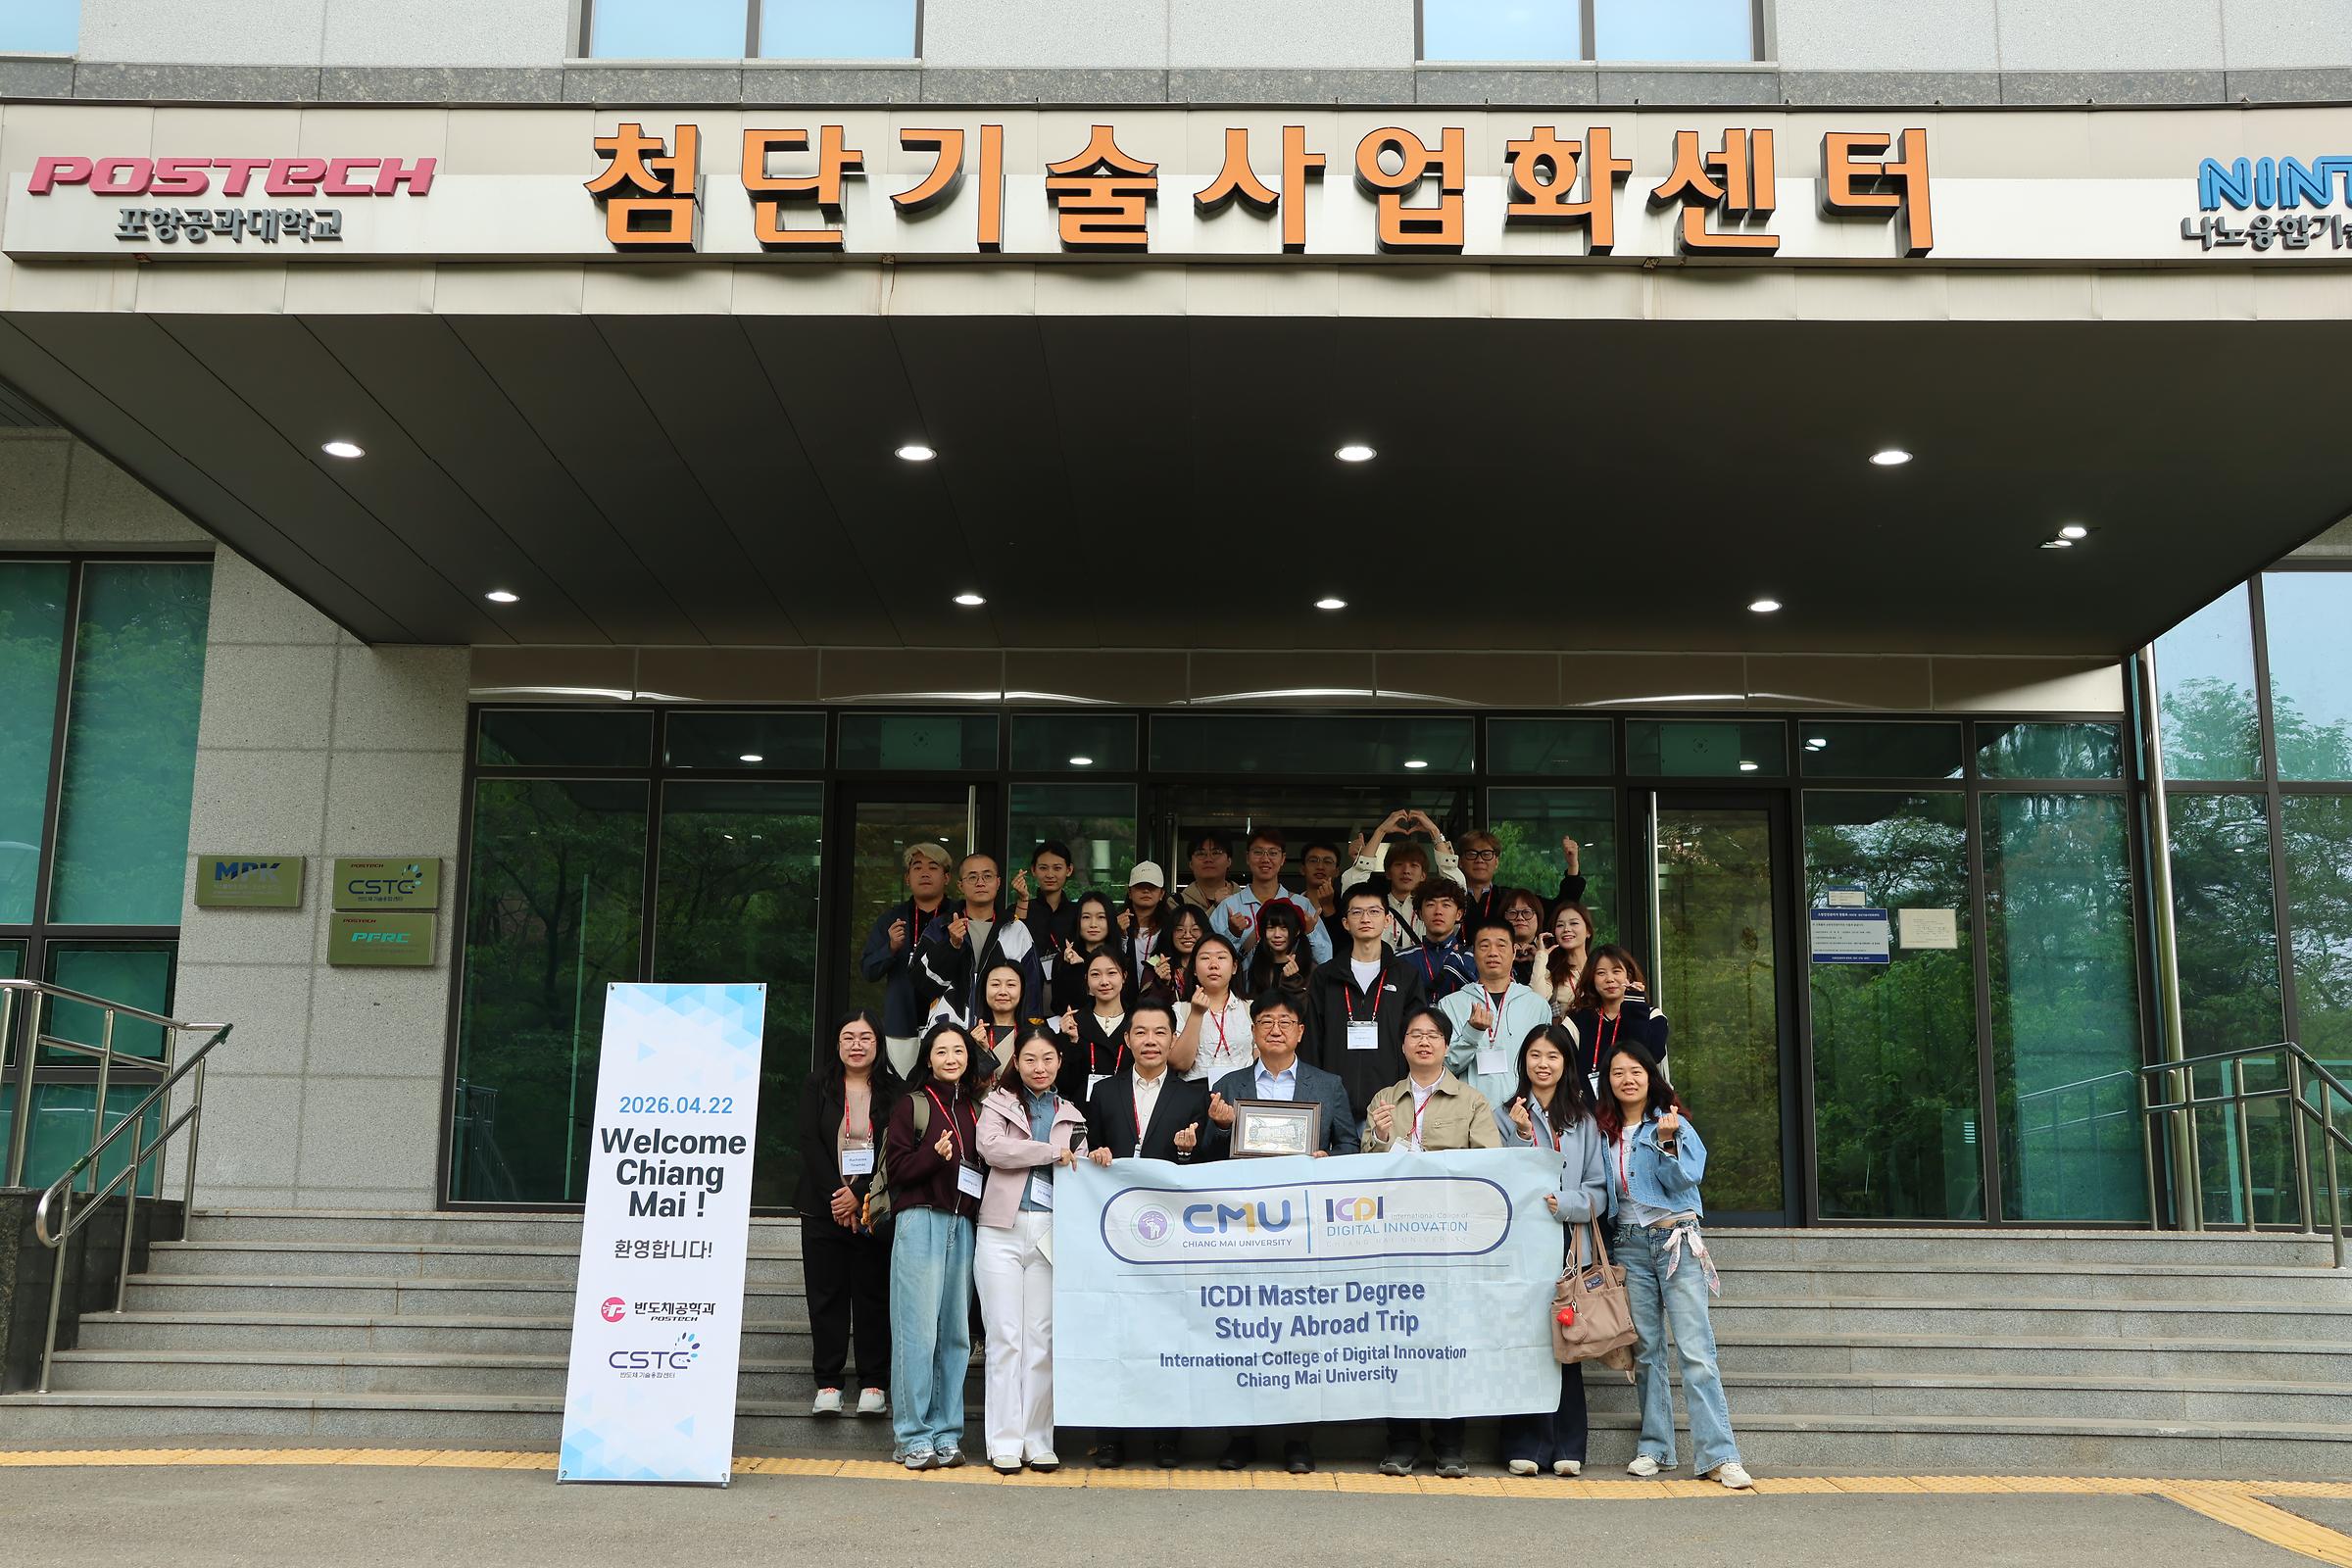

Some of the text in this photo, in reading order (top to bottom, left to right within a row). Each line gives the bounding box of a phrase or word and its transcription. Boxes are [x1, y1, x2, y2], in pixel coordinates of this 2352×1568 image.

[583, 122, 1935, 257] 첨단기술사업화센터
[114, 207, 343, 244] 포항공과대학교
[2180, 214, 2352, 252] 나노융합기
[348, 879, 414, 895] CSTC
[618, 1096, 733, 1114] 2026.04.22
[600, 1127, 747, 1154] Welcome
[615, 1158, 724, 1194] Chiang
[628, 1191, 686, 1217] Mai
[1182, 1199, 1292, 1234] CMU
[1325, 1196, 1384, 1223] ICDI
[1326, 1221, 1468, 1237] DIGITAL INNOVATON
[613, 1239, 712, 1259] 환영합니다!
[1182, 1240, 1217, 1249] CHIANG
[1239, 1239, 1293, 1248] UNIVERSITY
[1200, 1281, 1426, 1307] ICDI Master Degree
[634, 1301, 716, 1316] 반도체공학과
[1215, 1309, 1419, 1344] Study Abroad Trip
[609, 1350, 689, 1369] CSTC
[1159, 1344, 1467, 1367] International College of Digital Innovation
[1236, 1365, 1398, 1390] Chiang Mai University
